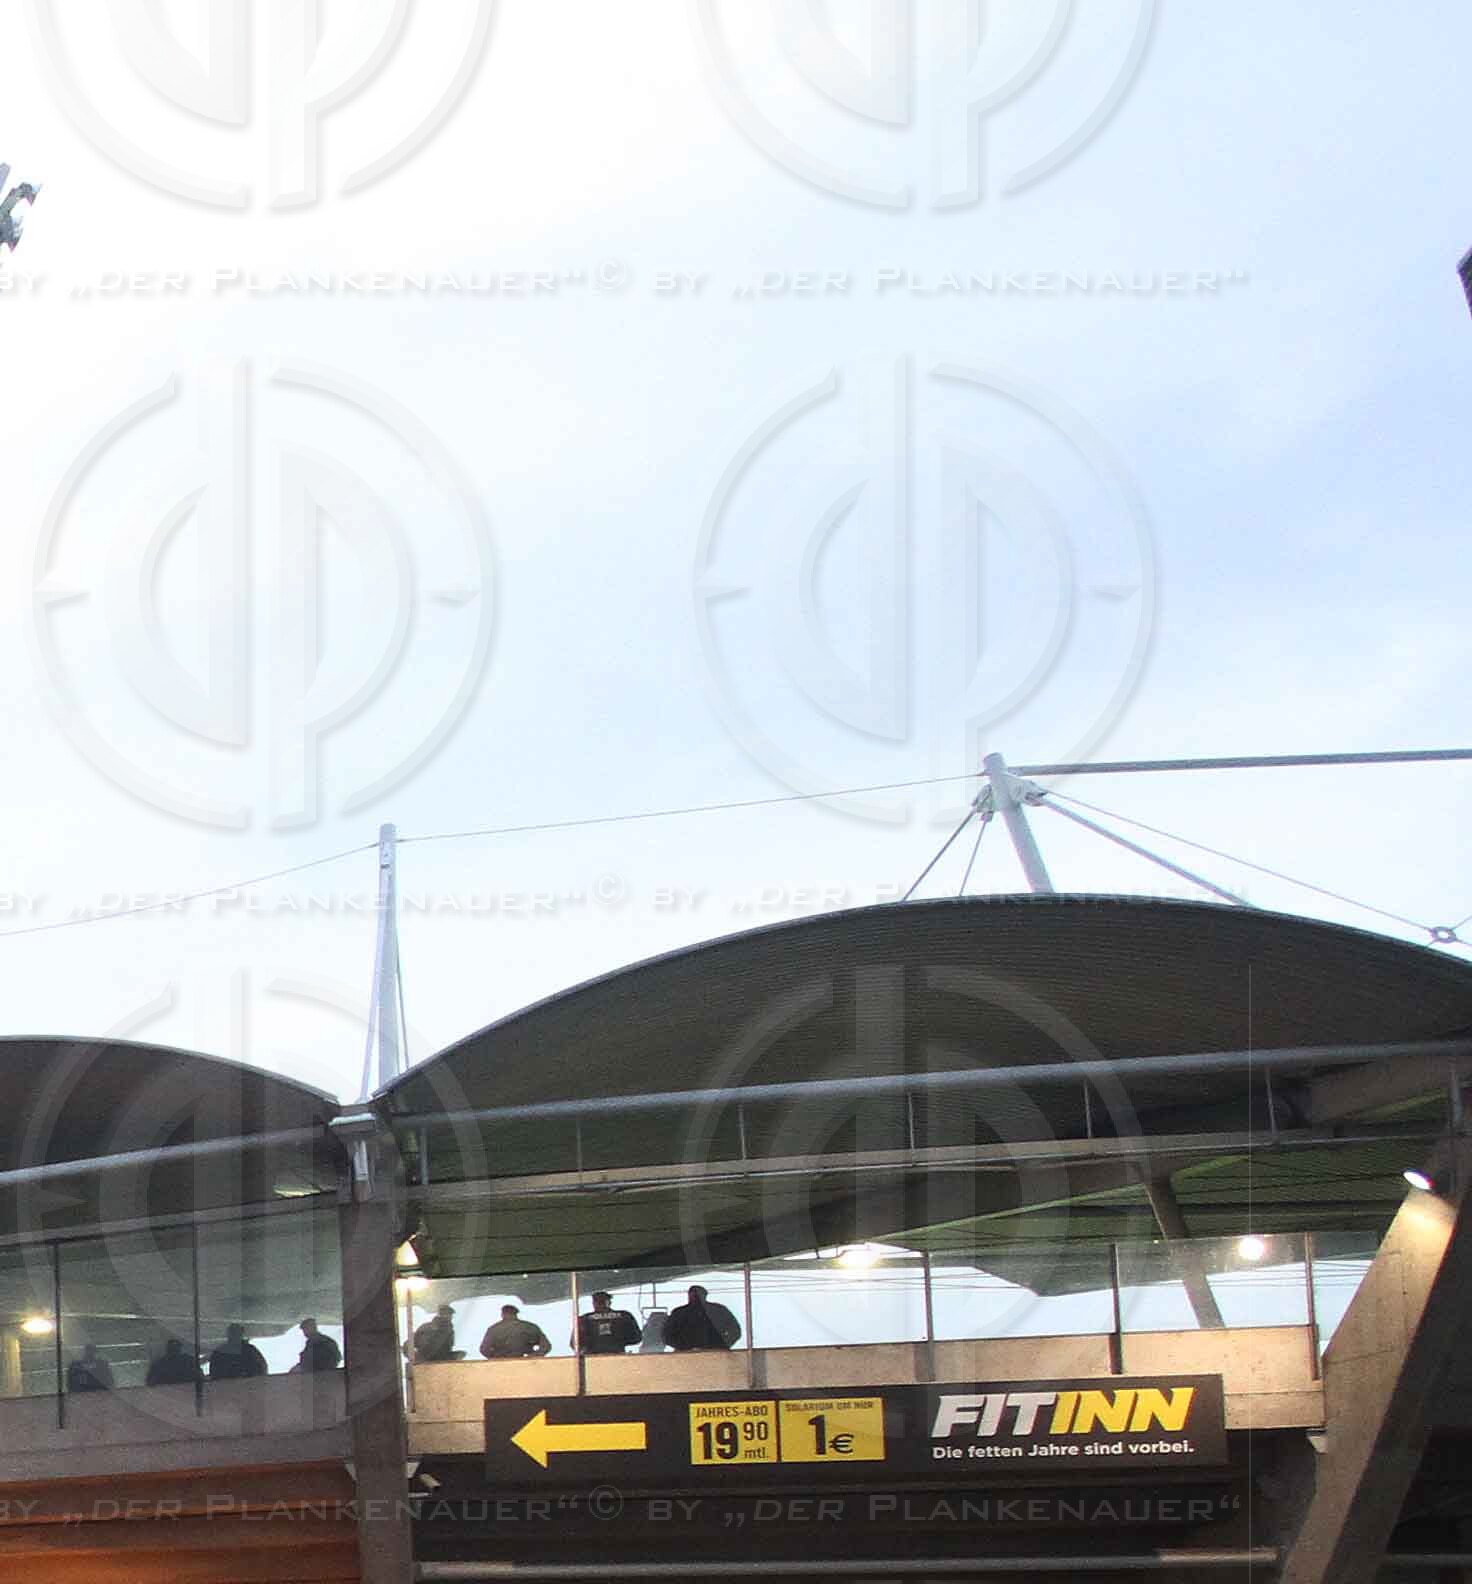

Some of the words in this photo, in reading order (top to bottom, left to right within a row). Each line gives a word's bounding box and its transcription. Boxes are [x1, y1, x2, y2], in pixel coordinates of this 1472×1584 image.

[696, 1405, 768, 1418] JAHRES-ABO
[930, 1387, 1195, 1438] FITINN
[744, 1447, 770, 1459] mtl.
[932, 1446, 962, 1460] Die
[967, 1445, 1023, 1459] fetten
[1027, 1443, 1080, 1457] Jahre
[1084, 1441, 1123, 1456] sind
[1127, 1439, 1195, 1455] vorbei.
